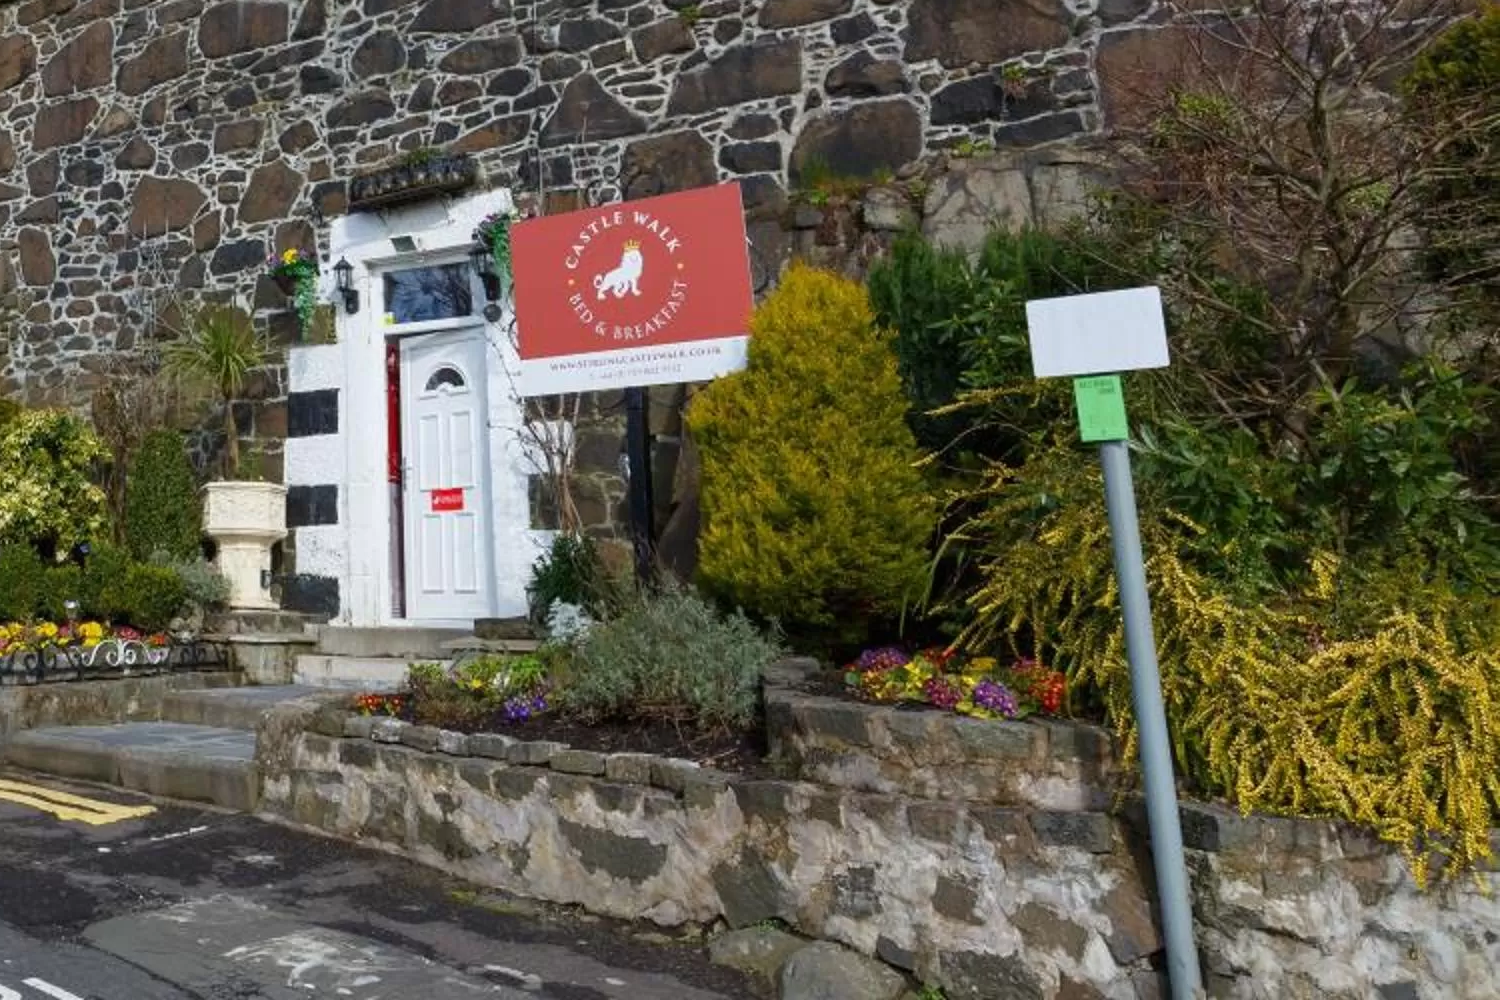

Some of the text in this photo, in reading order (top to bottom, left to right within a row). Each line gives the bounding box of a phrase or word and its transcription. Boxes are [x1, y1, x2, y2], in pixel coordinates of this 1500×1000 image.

[565, 211, 681, 269] CASTLE WALK
[569, 280, 687, 340] BED & BREAKFAST
